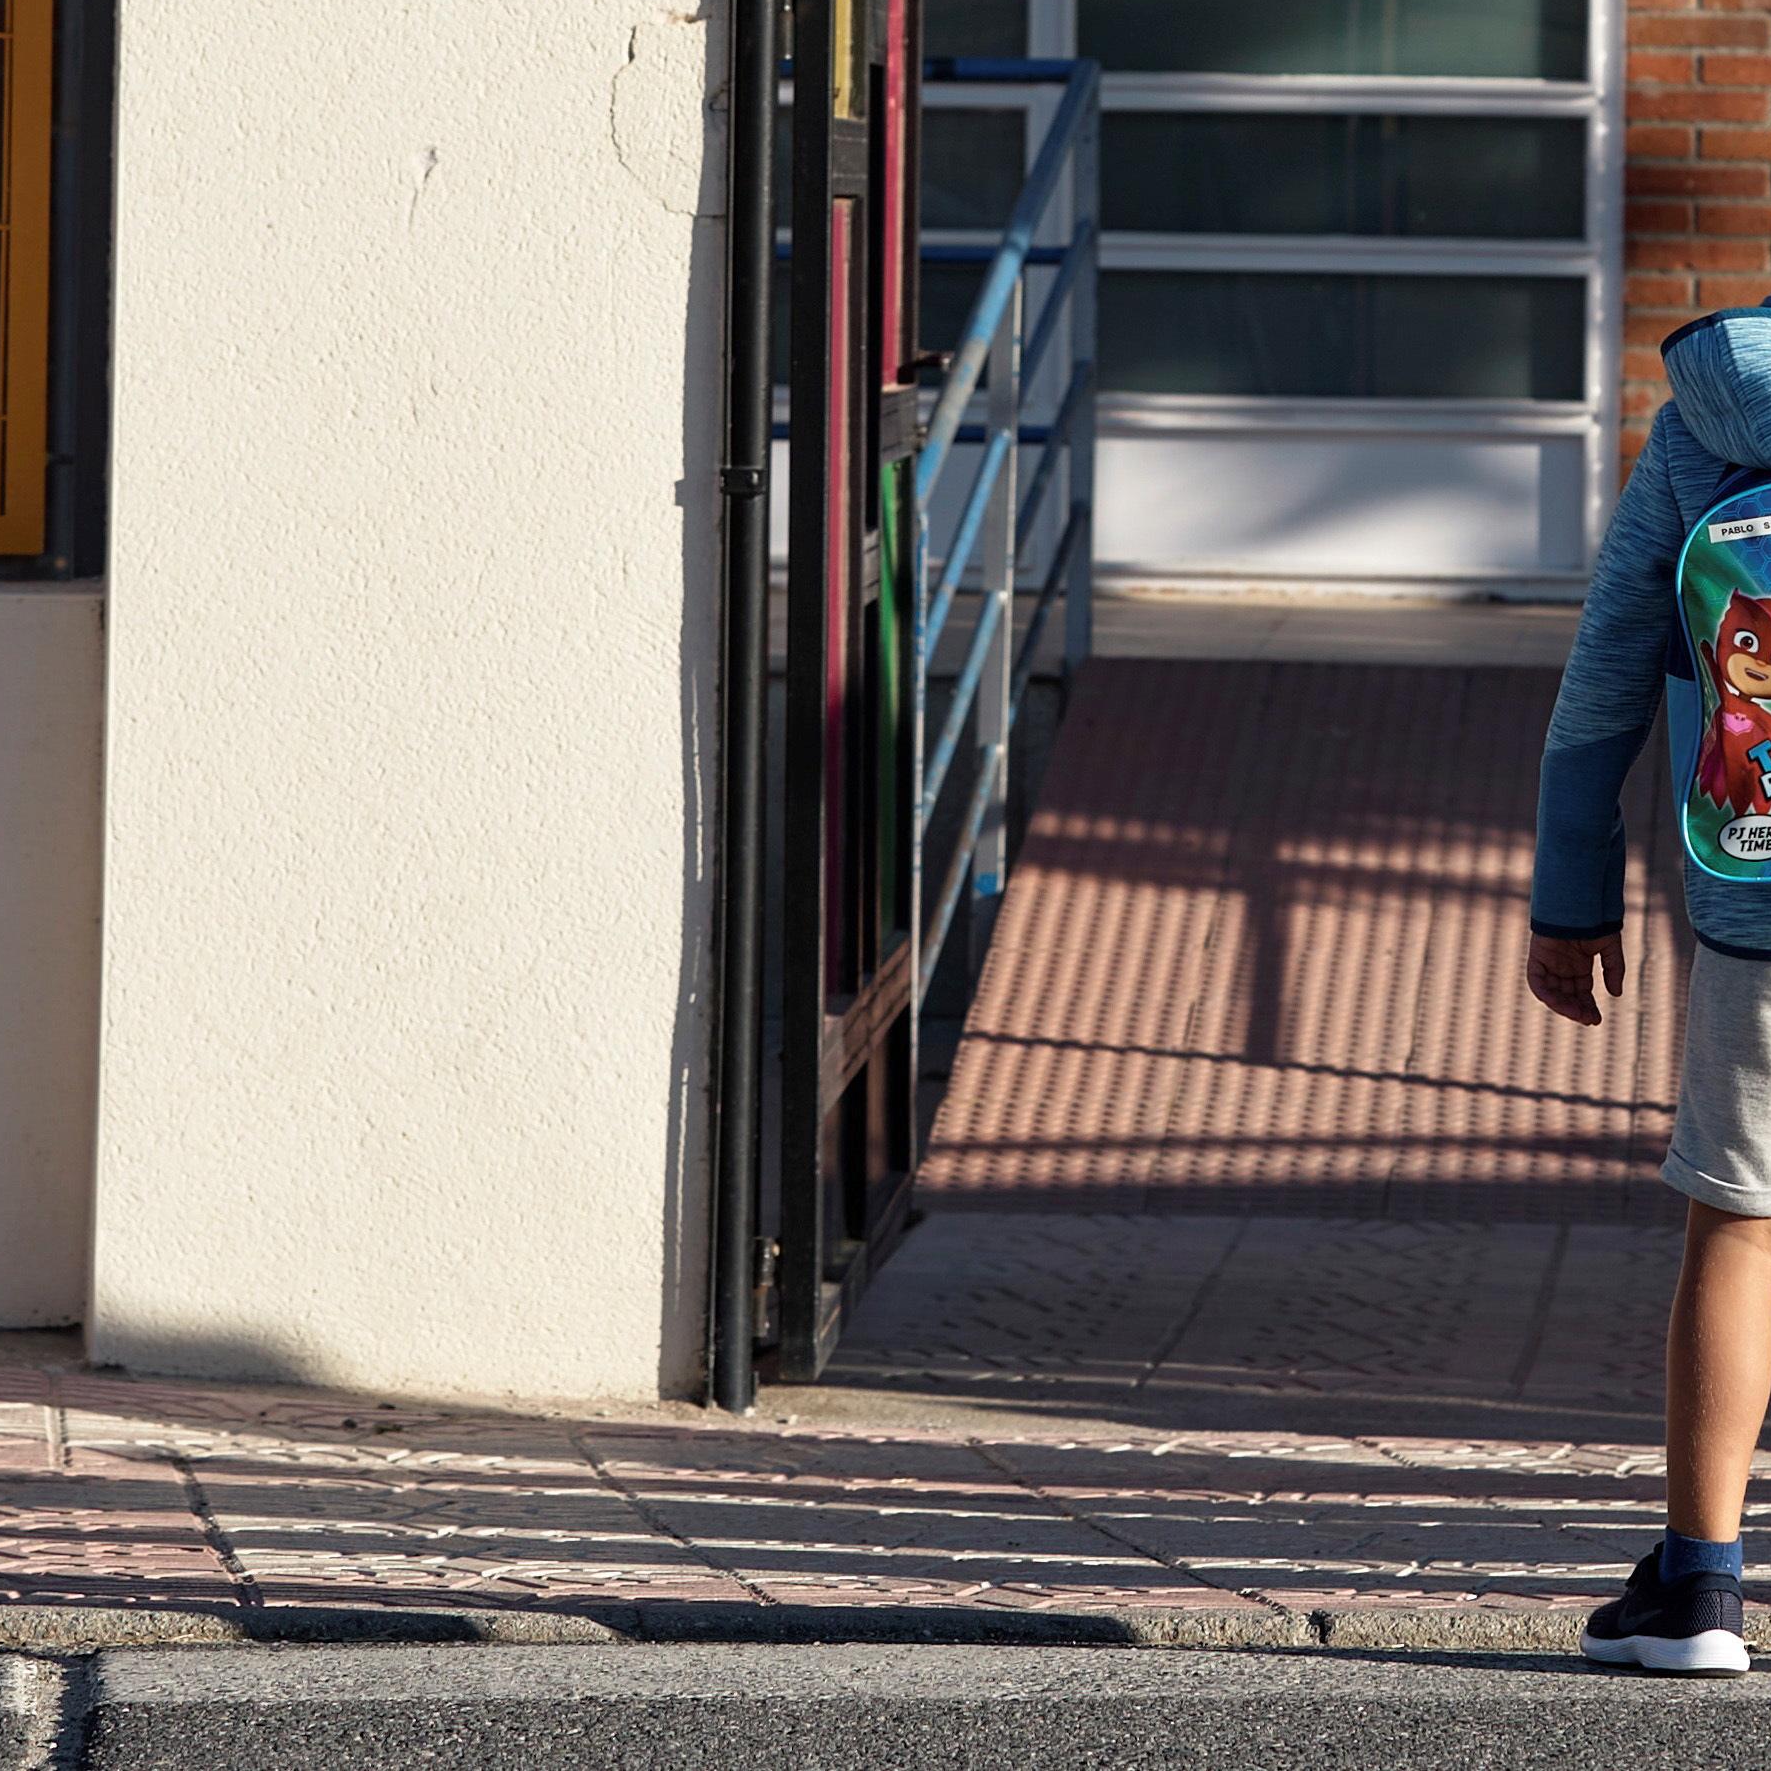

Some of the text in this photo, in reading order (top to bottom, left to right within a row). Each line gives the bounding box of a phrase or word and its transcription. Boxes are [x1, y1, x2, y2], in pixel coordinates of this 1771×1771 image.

[1721, 524, 1754, 536] PABLO
[1763, 522, 1771, 530] S
[1727, 827, 1746, 840] PJ
